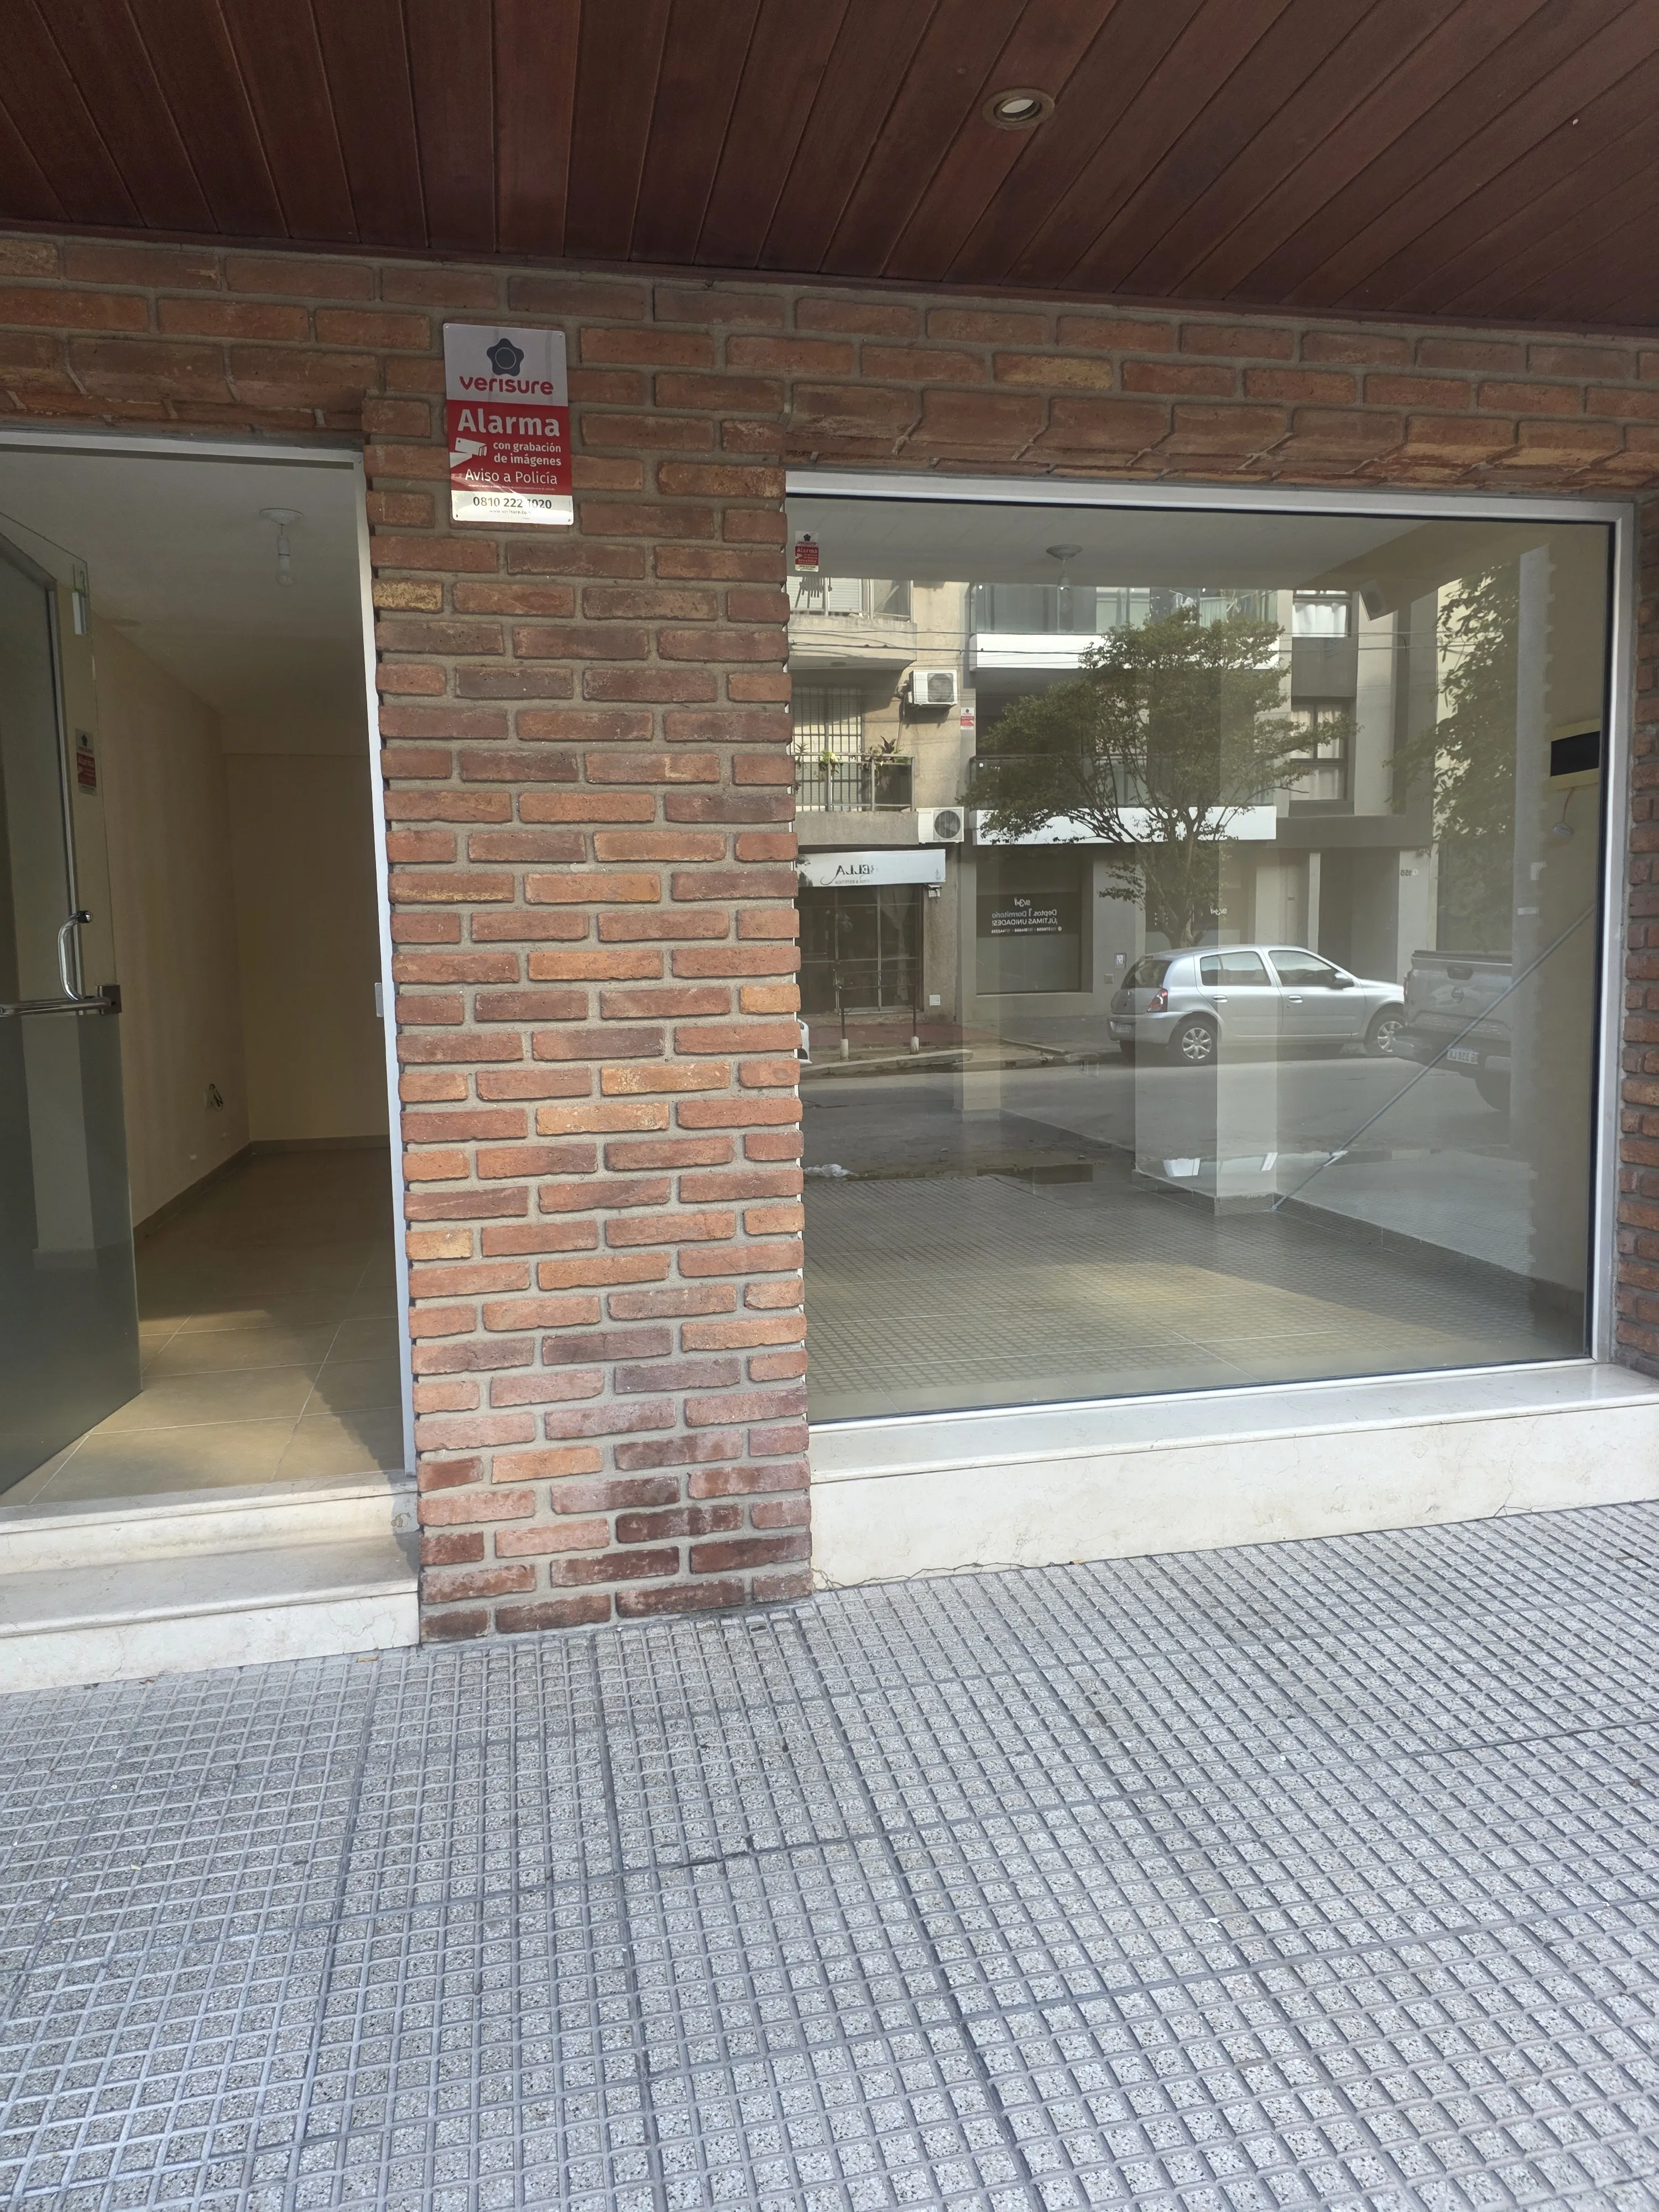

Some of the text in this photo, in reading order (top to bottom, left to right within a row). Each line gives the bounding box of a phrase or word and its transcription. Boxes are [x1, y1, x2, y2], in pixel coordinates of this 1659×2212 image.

[459, 375, 554, 395] verisure
[457, 408, 560, 437] Alarma
[513, 442, 561, 452] grabación
[494, 453, 561, 467] de imágenes
[465, 468, 558, 484] Aviso a Policía
[473, 497, 552, 509] 0810 222 1020
